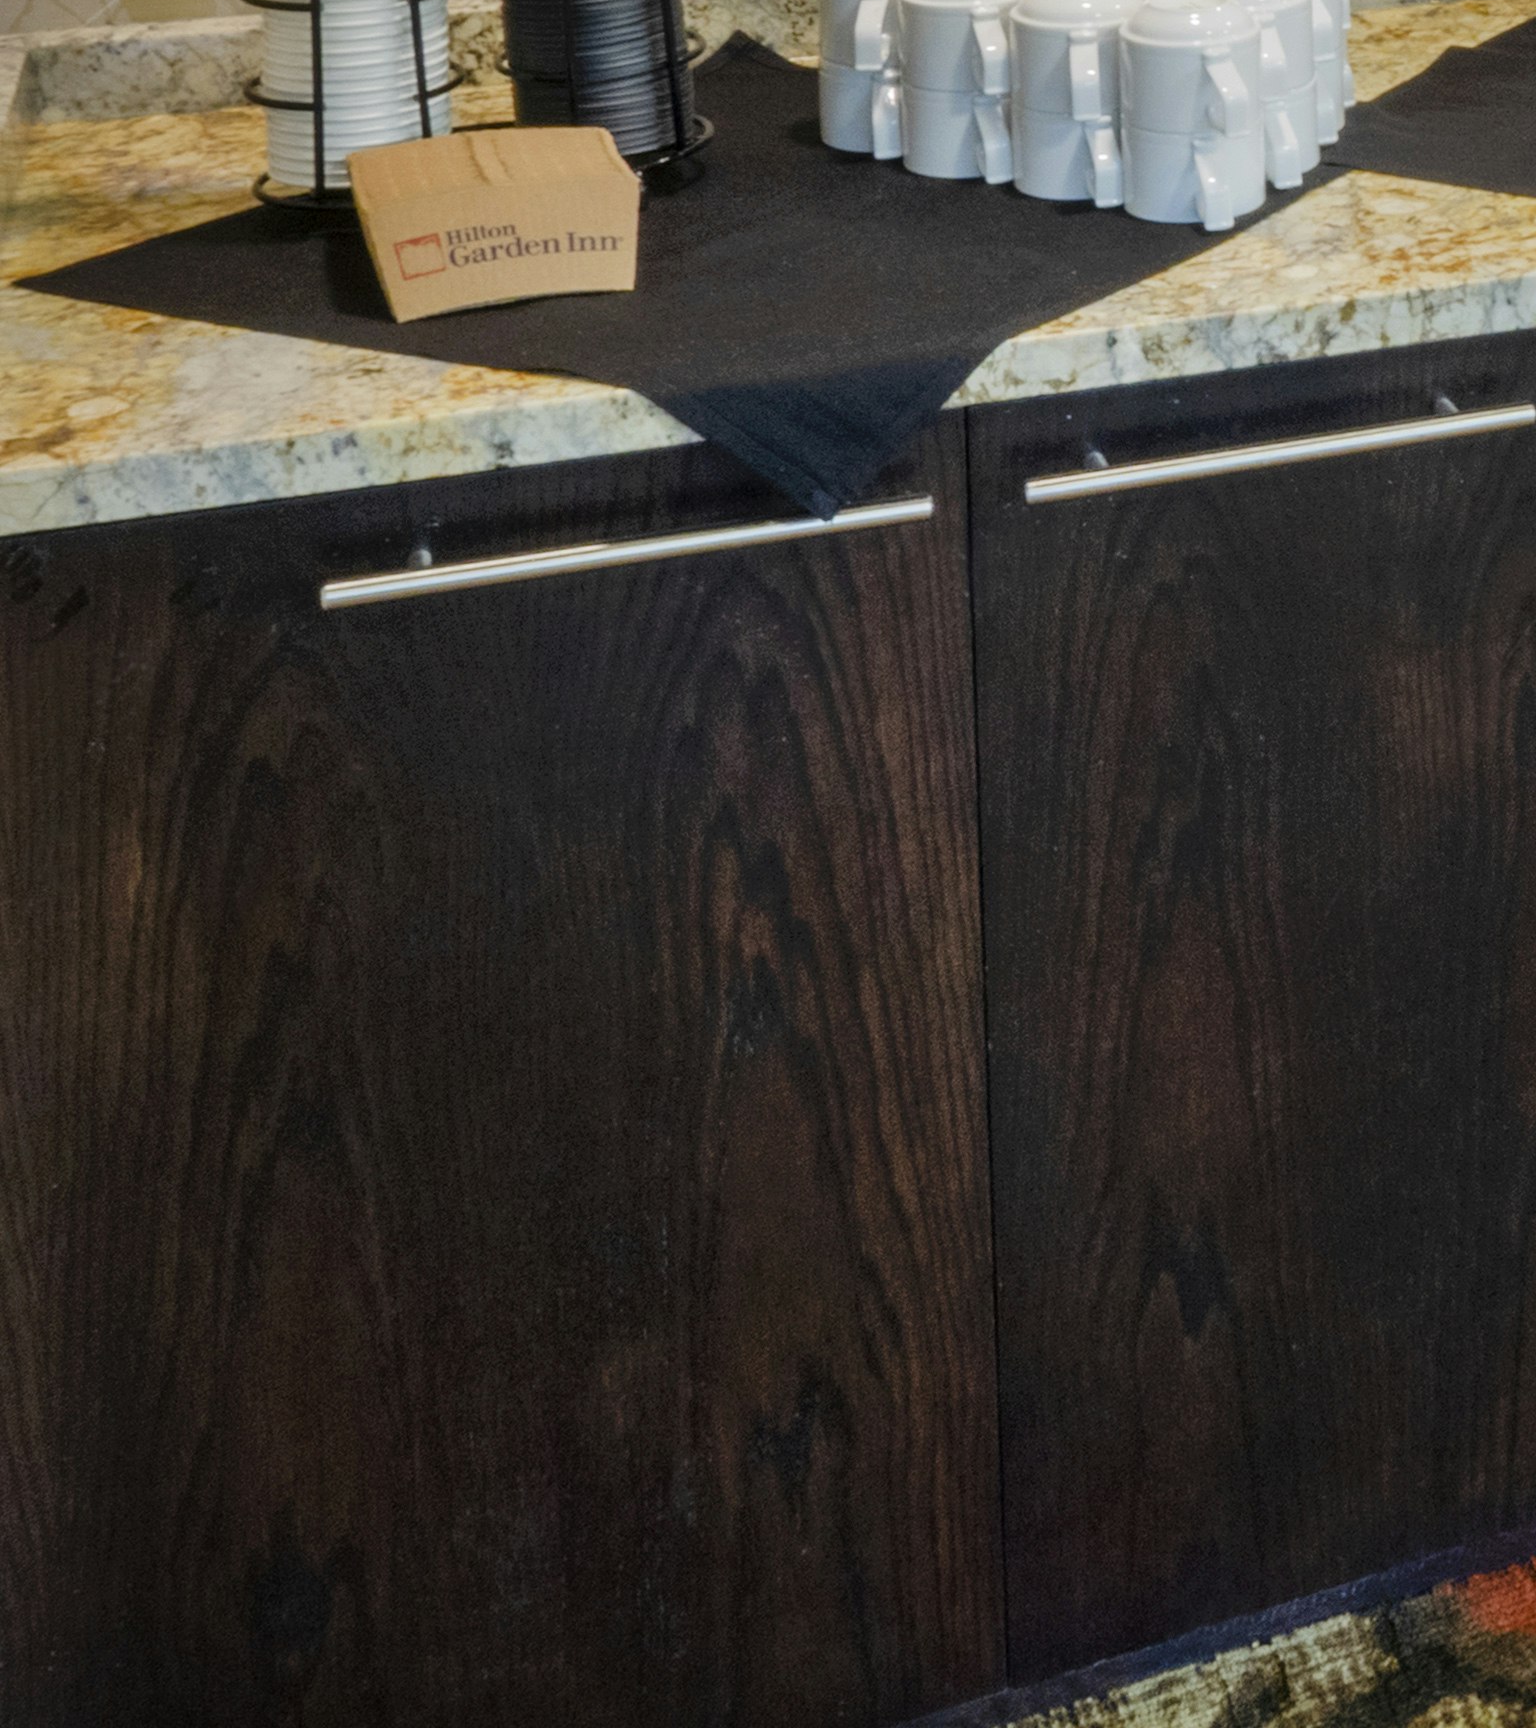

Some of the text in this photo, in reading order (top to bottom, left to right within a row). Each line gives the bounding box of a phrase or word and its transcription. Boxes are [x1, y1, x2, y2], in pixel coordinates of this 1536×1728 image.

[445, 223, 517, 246] Hilton
[449, 231, 620, 268] Garden Inn
